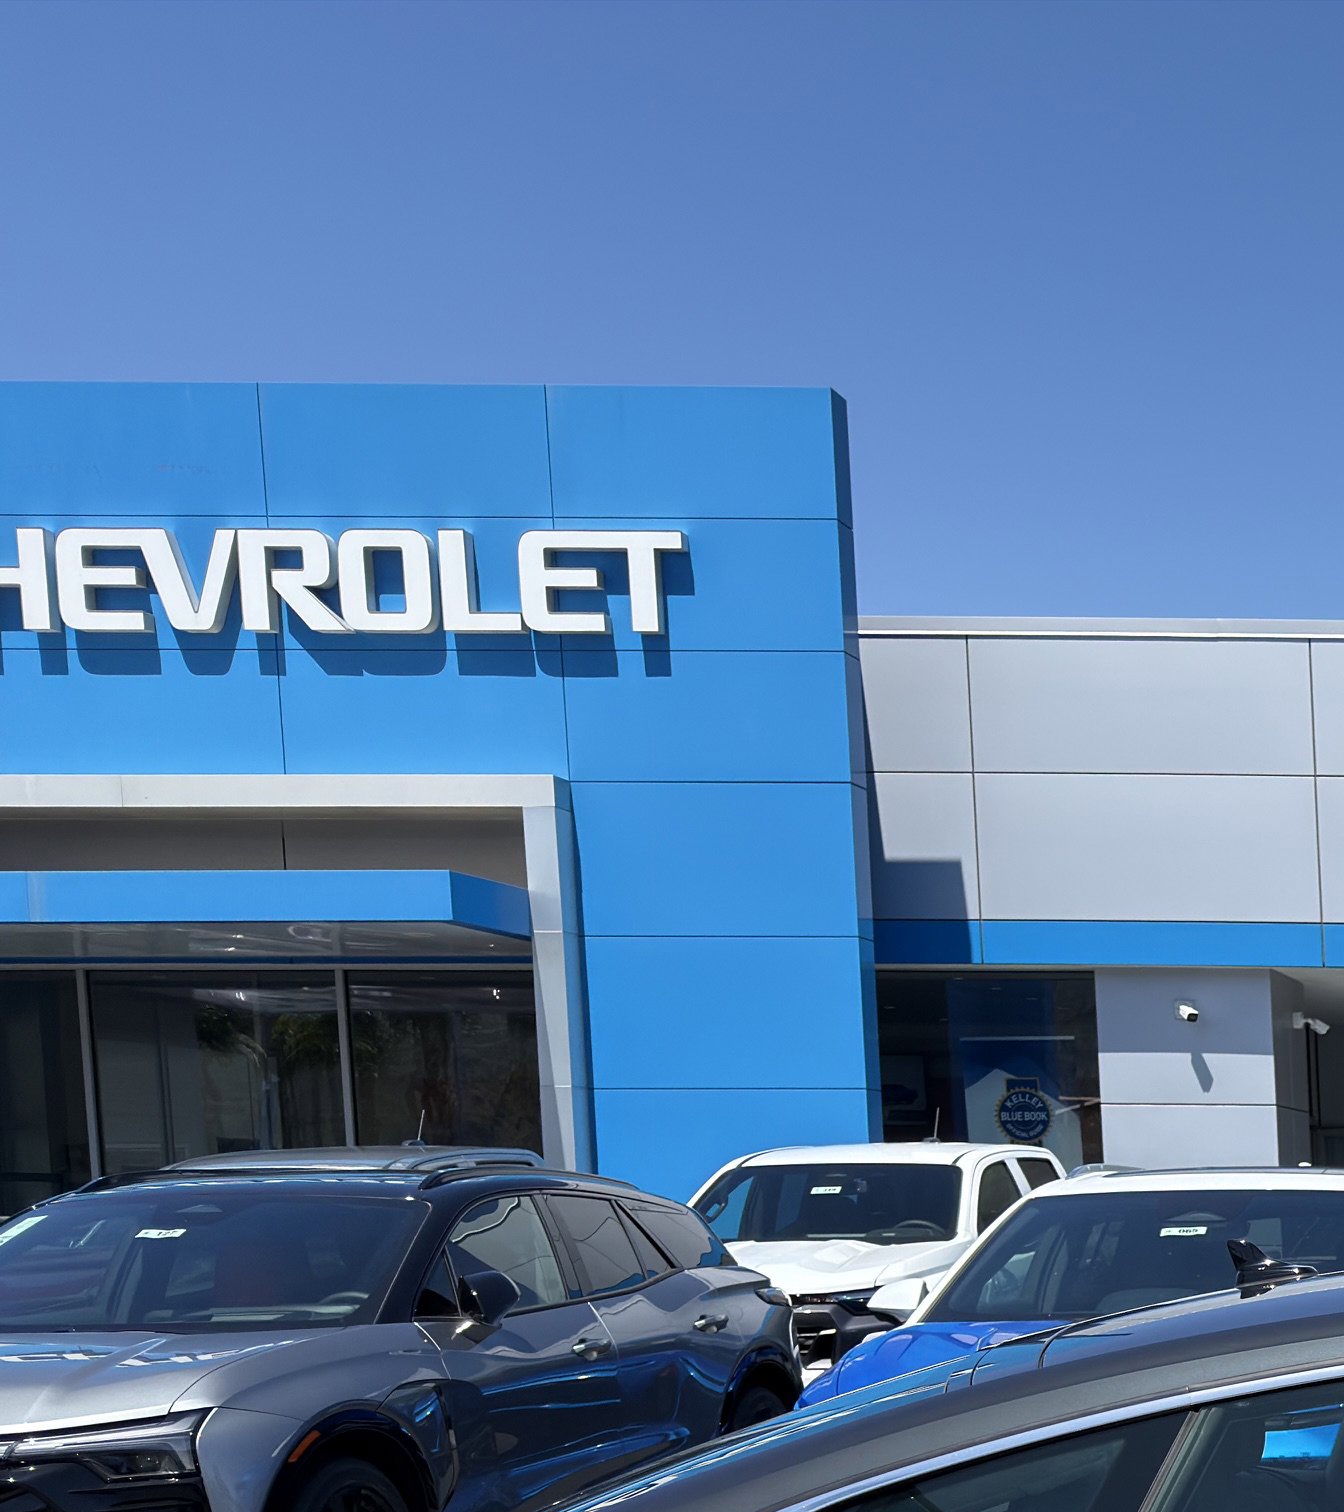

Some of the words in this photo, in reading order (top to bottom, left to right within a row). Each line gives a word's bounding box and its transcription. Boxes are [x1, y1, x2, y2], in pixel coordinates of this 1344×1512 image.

[1005, 1093, 1043, 1108] KELLEY
[1001, 1111, 1023, 1121] BLUE
[1024, 1111, 1048, 1121] BOOK
